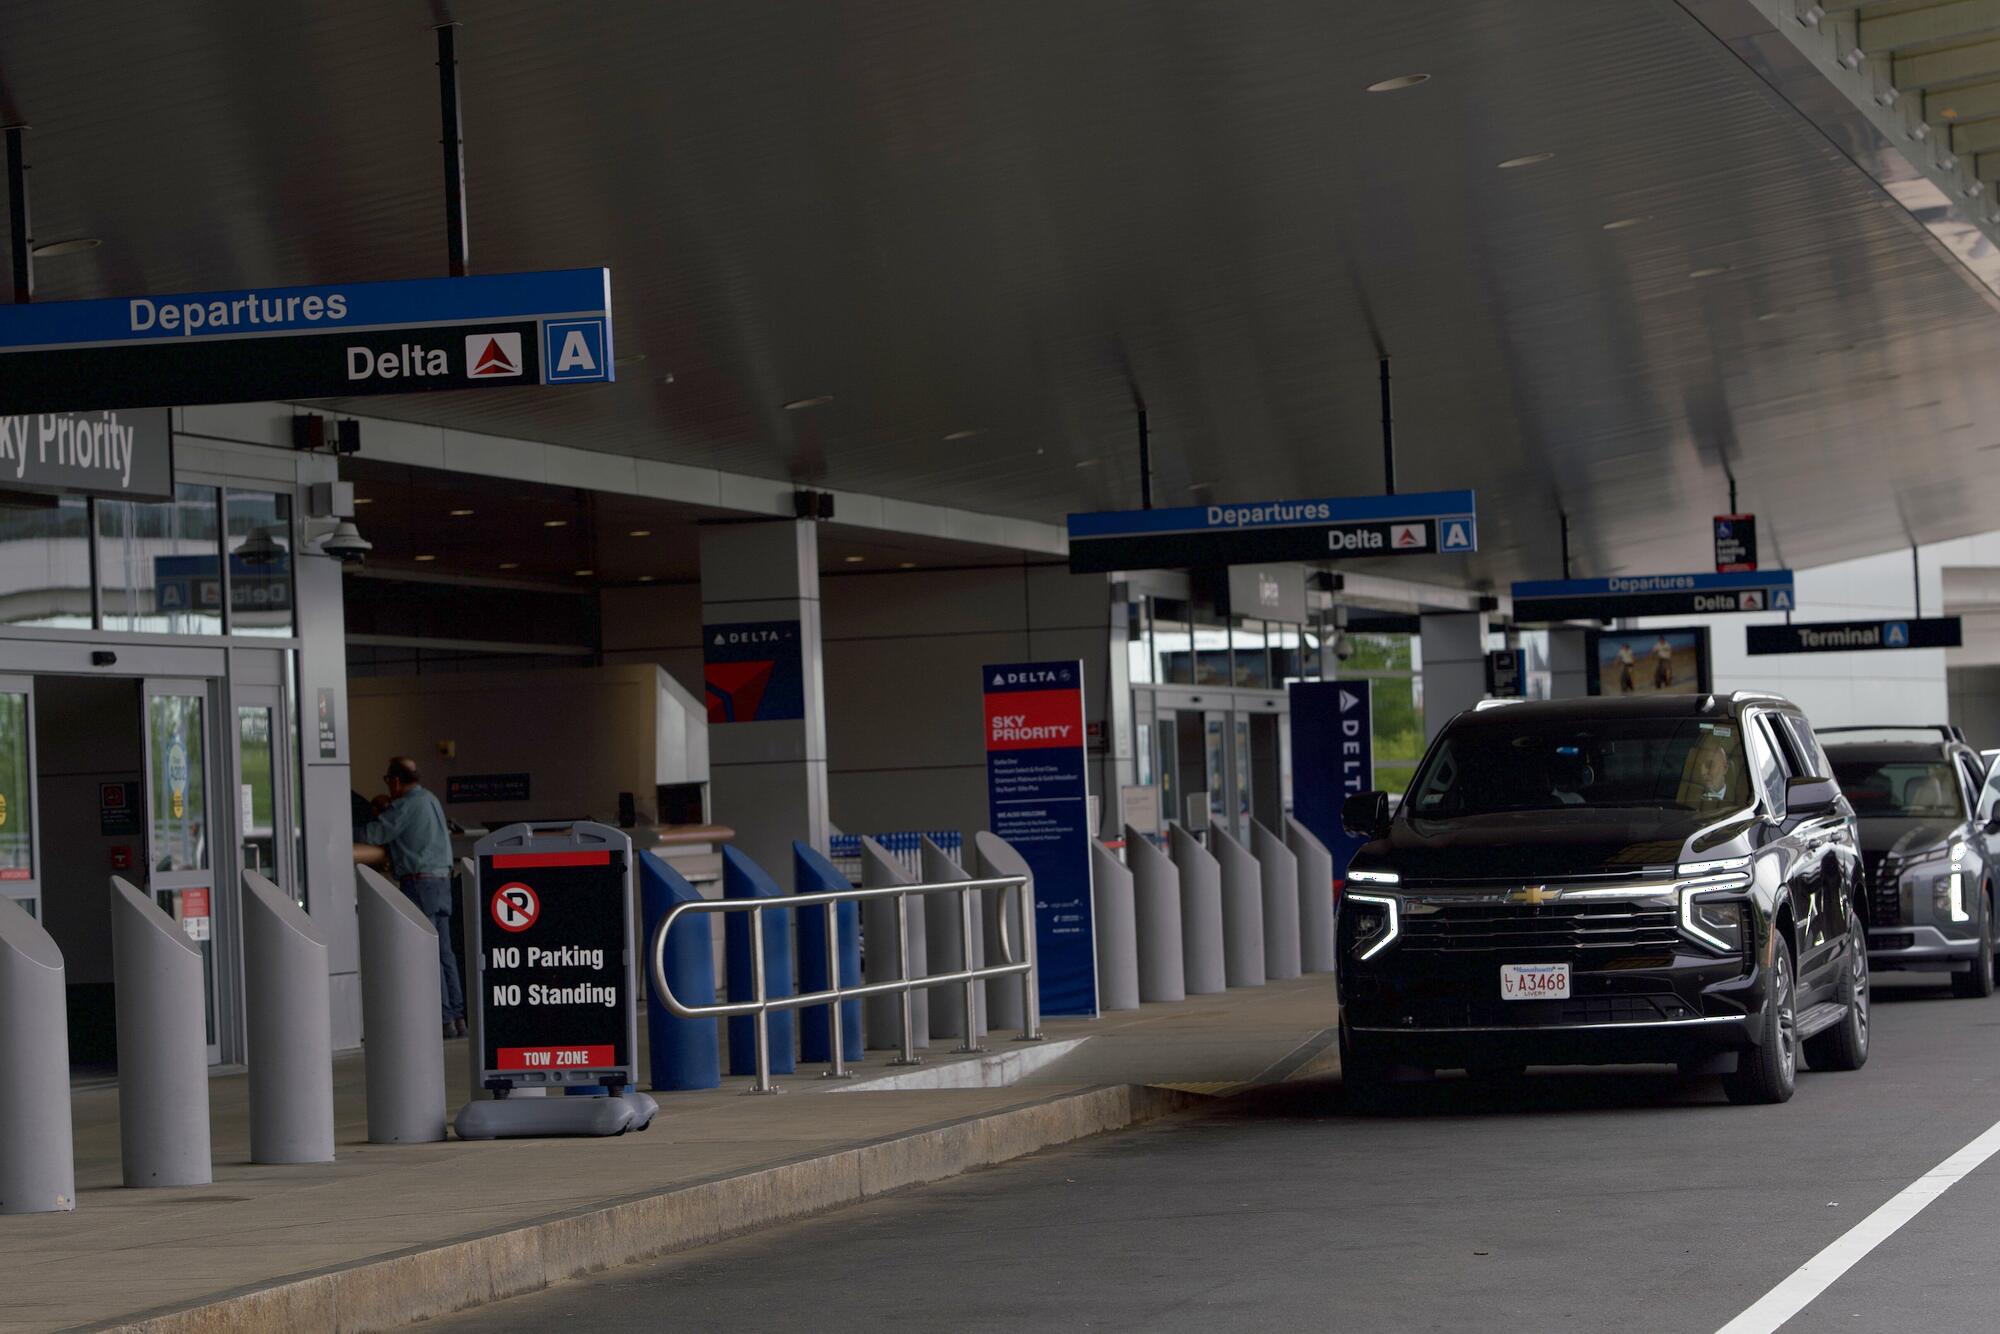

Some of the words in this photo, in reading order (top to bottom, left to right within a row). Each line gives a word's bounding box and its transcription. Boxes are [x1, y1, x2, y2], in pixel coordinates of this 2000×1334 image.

[129, 293, 348, 336] Departures
[556, 330, 596, 372] A
[346, 344, 449, 381] Delta
[38, 411, 134, 489] Priority
[1207, 502, 1330, 527] Departures
[1328, 529, 1383, 551] Delta
[1445, 522, 1470, 547] A
[1608, 574, 1694, 593] Departures
[1694, 595, 1735, 611] Delta
[1774, 591, 1791, 608] A
[728, 630, 779, 644] DELTA
[1798, 627, 1880, 648] Terminal
[1888, 625, 1905, 643] A
[1007, 671, 1056, 684] DELTA
[992, 715, 1025, 729] SKY
[992, 725, 1070, 741] PRIORITY
[1341, 719, 1361, 800] DELT
[492, 947, 520, 969] NO
[527, 945, 604, 969] Parking
[1518, 973, 1566, 991] A3468
[493, 984, 521, 1006] NO
[528, 983, 616, 1007] Standing
[523, 1052, 551, 1065] TOW
[556, 1050, 589, 1065] ZONE
